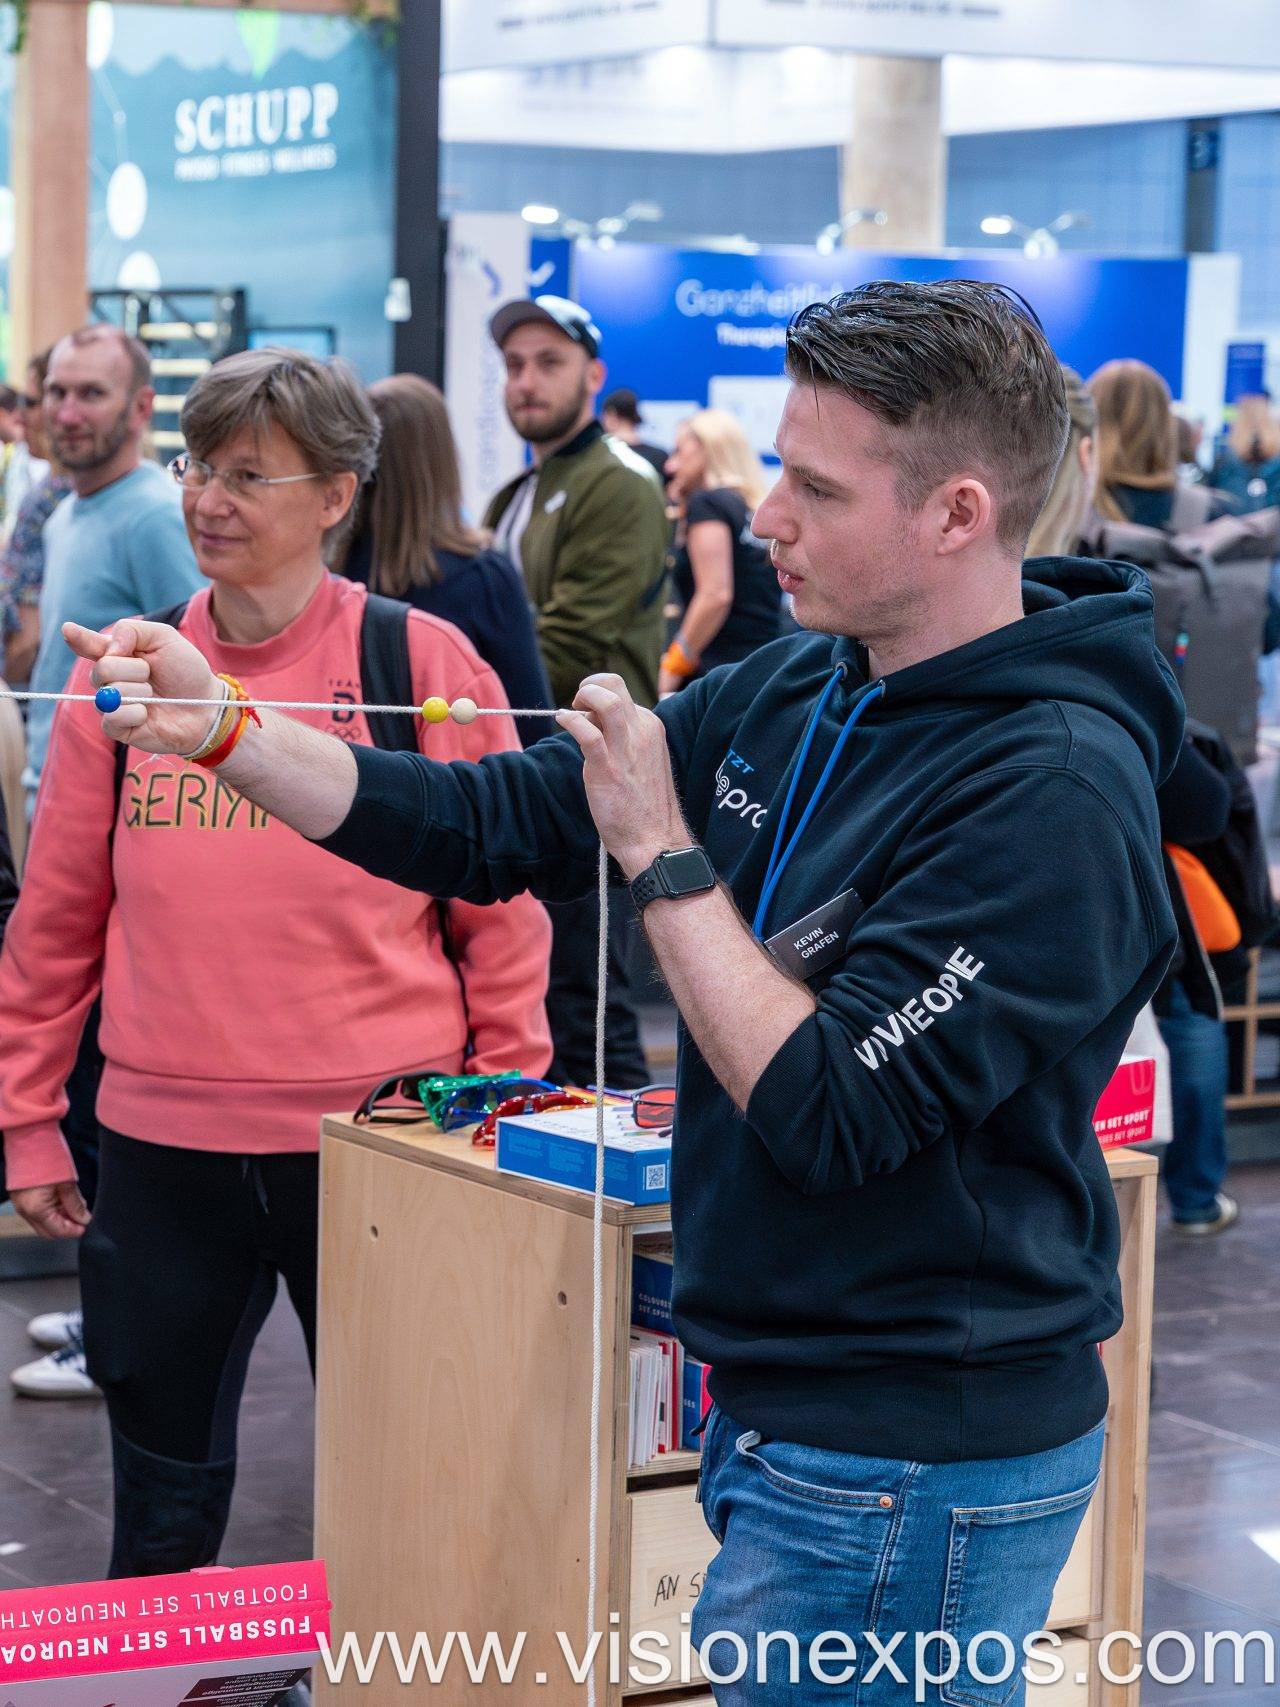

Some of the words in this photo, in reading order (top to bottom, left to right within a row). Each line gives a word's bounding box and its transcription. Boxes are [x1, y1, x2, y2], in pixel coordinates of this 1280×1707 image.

[174, 82, 339, 154] SCHUPP
[123, 772, 271, 829] GERM
[793, 927, 824, 950] KEVIN
[801, 931, 839, 959] GRAFEN
[138, 1595, 180, 1616] SET
[191, 1583, 308, 1610] FOOTBALL
[120, 1630, 168, 1653] SET
[179, 1615, 311, 1645] FUSSBALL
